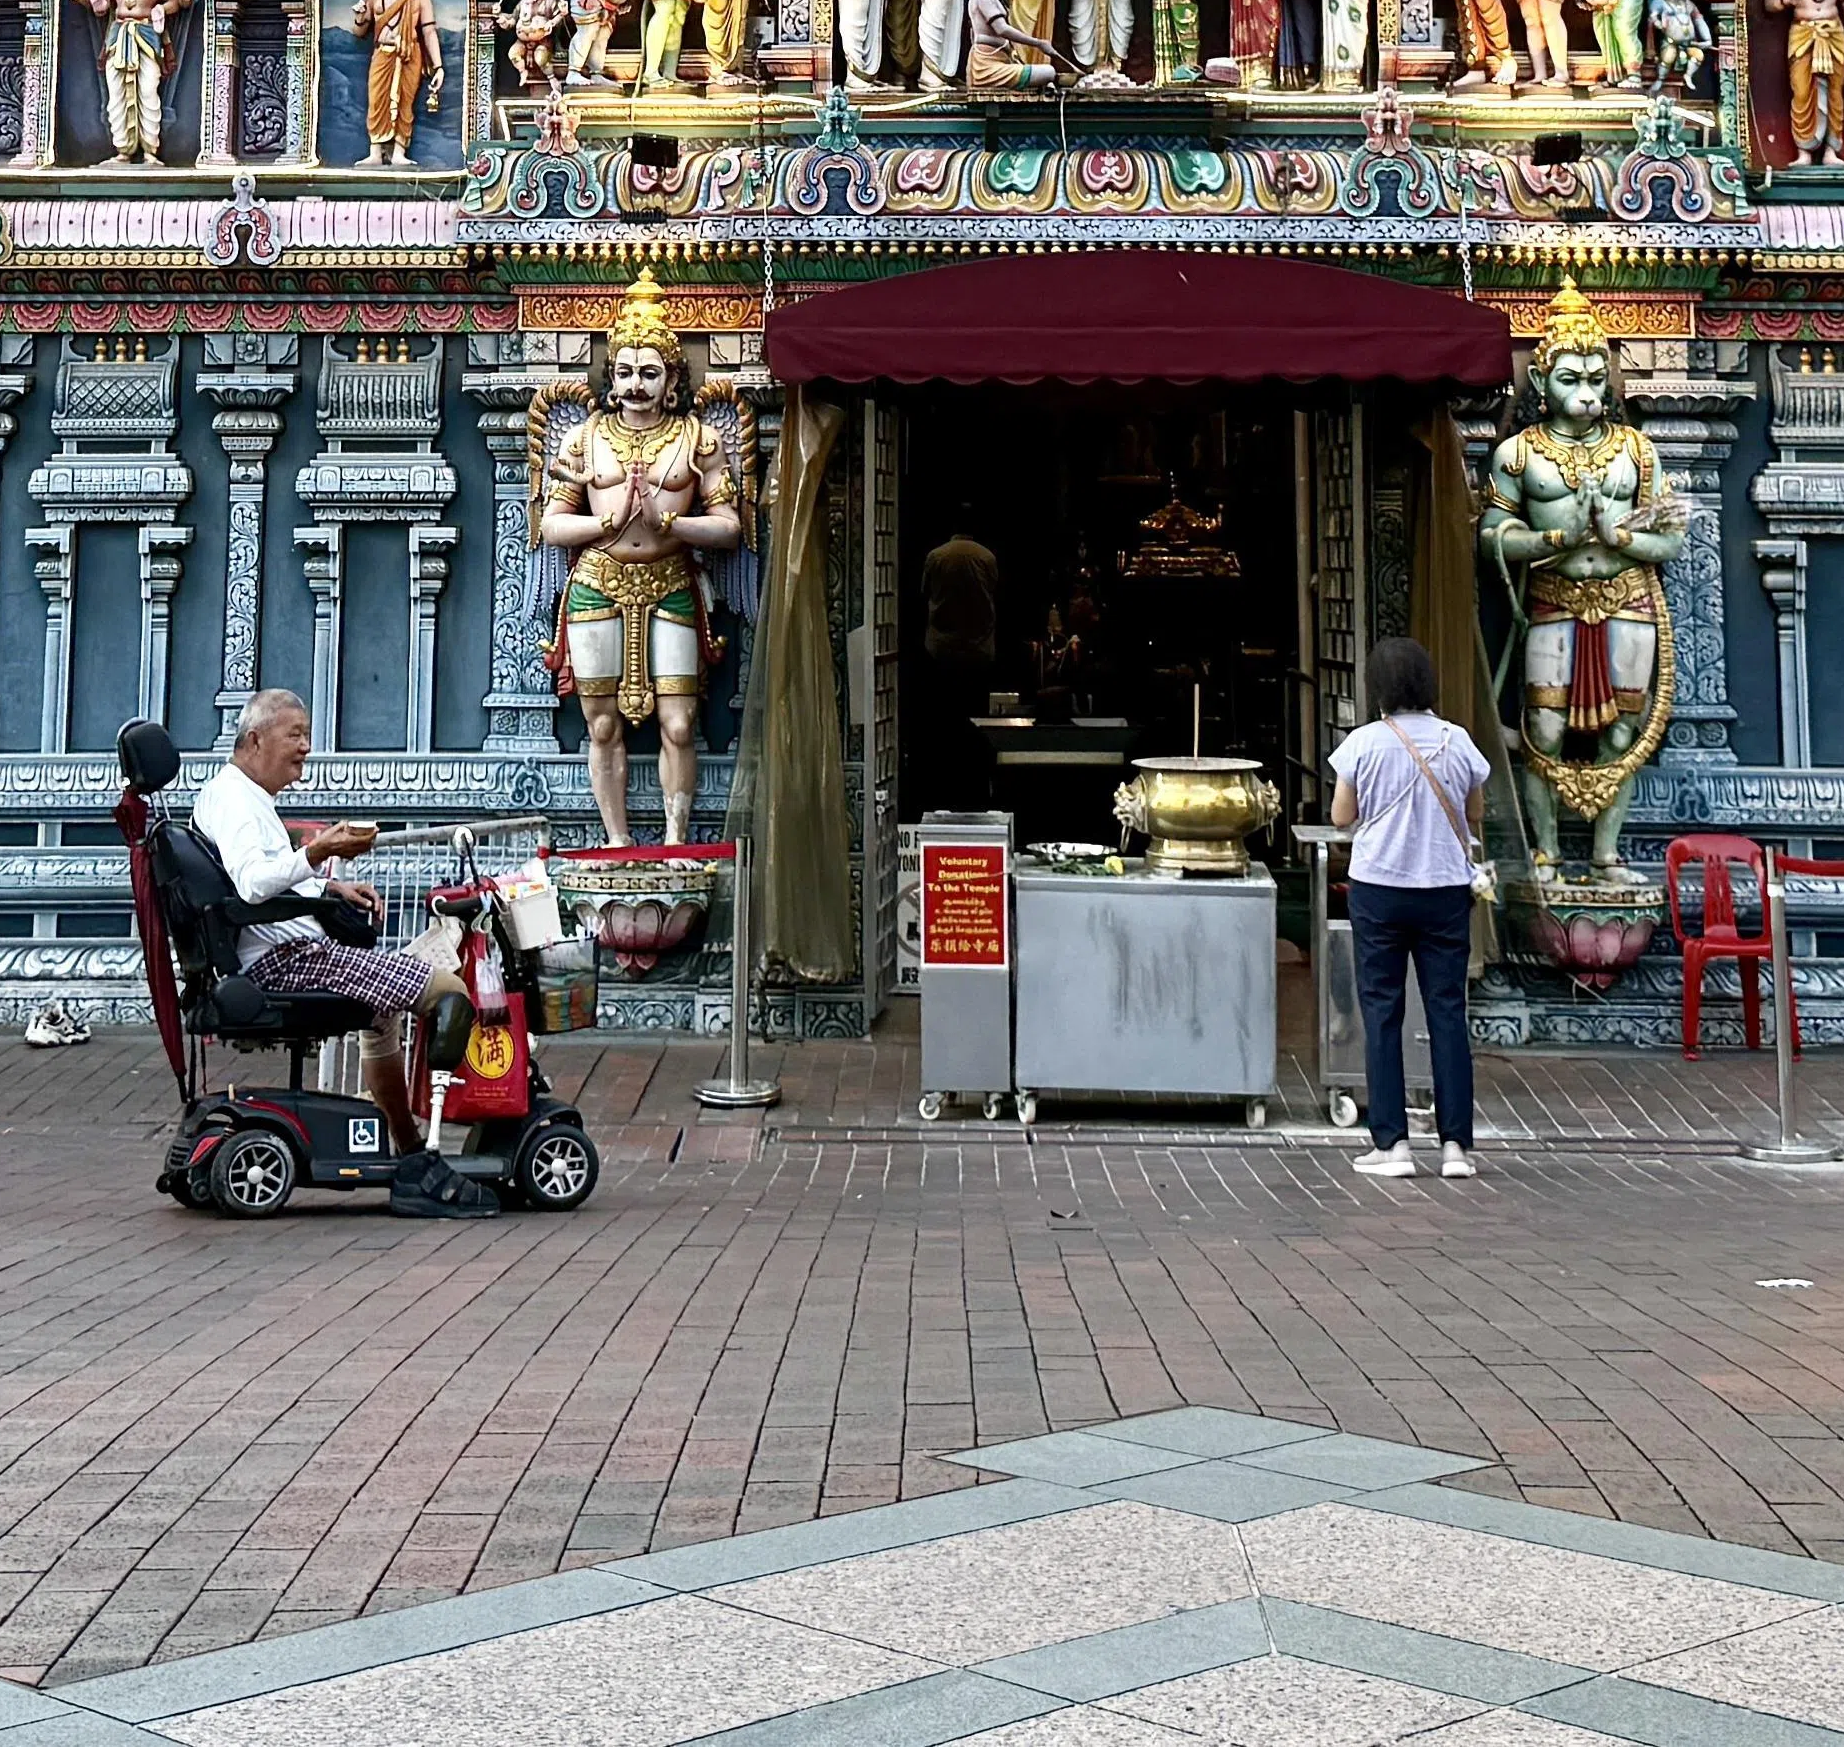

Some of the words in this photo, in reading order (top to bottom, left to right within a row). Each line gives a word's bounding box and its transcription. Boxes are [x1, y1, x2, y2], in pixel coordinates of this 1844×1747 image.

[939, 856, 988, 868] Voluntary
[938, 869, 989, 880] Donations
[927, 882, 942, 892] To
[943, 882, 960, 892] the
[962, 882, 1000, 893] Temple
